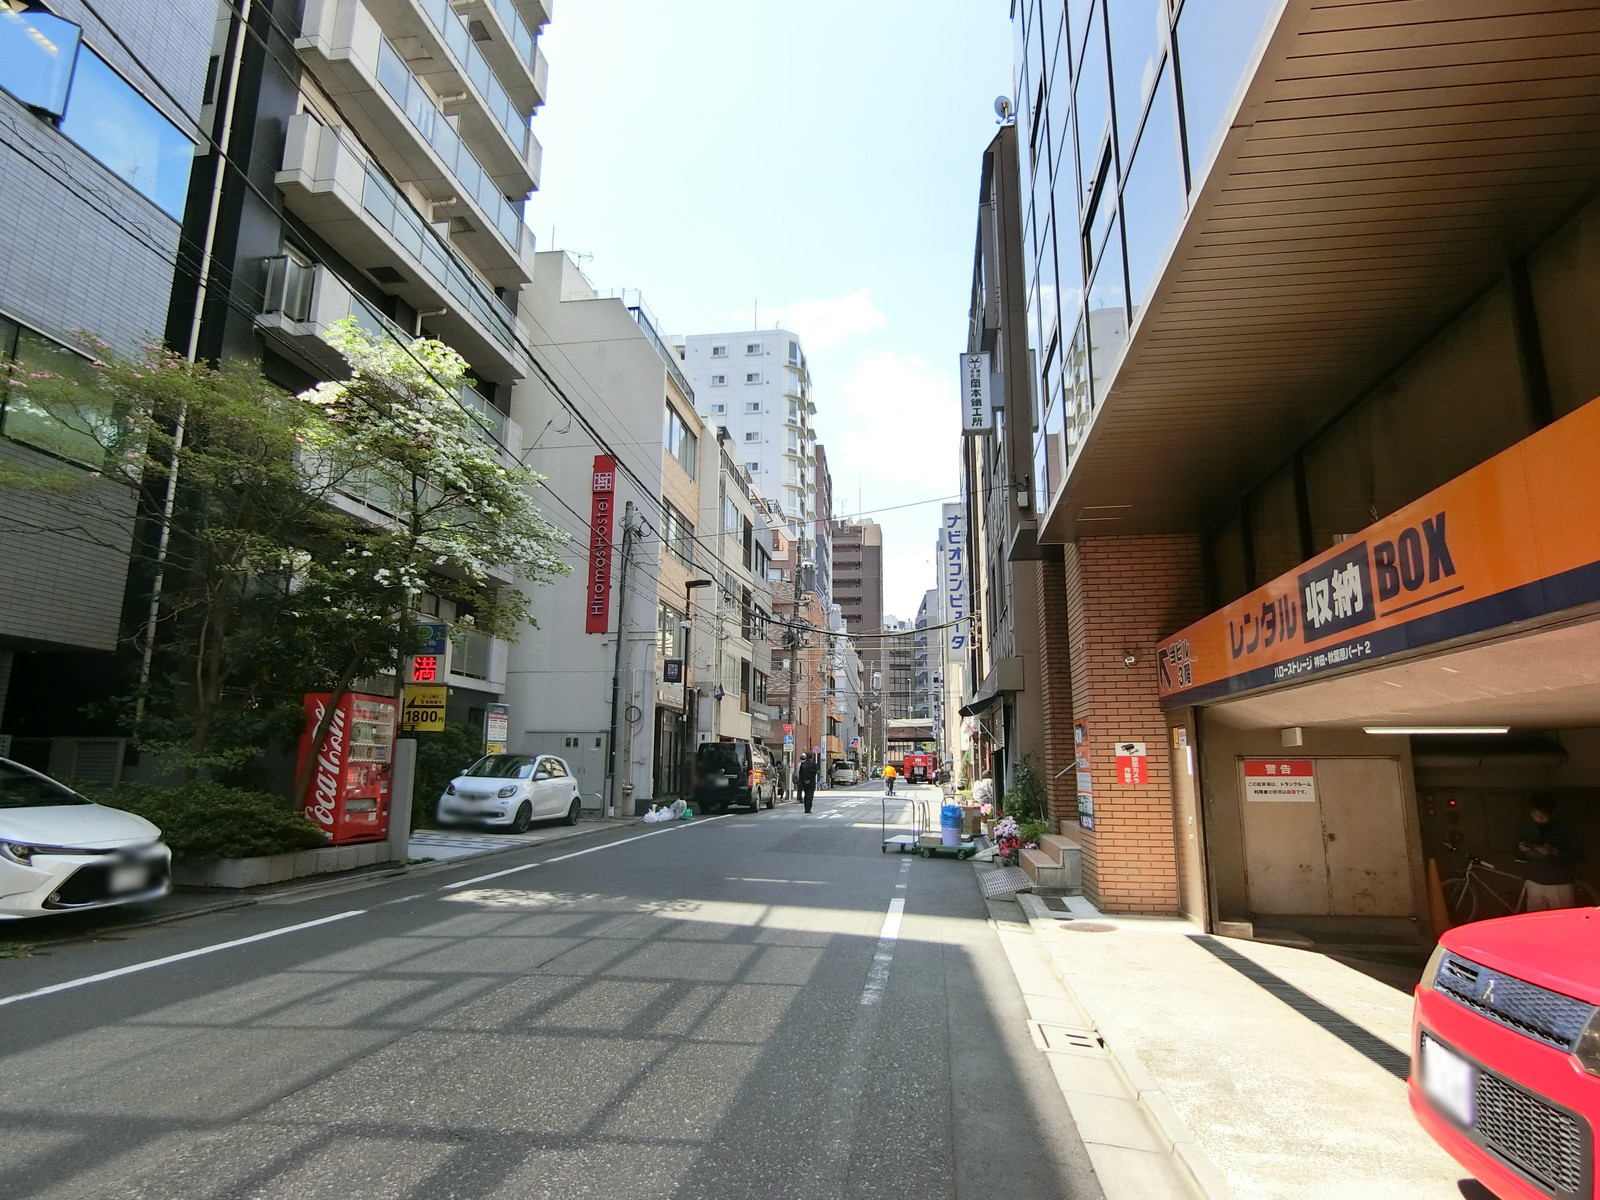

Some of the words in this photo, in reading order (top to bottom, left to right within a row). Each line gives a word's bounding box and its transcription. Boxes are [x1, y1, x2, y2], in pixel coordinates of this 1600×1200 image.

[1305, 562, 1363, 629] 収納
[1373, 511, 1457, 602] BOX
[947, 515, 965, 650] ナビオコンピュータ
[413, 656, 437, 681] 満
[1274, 656, 1313, 679] ハローストレージ
[405, 710, 444, 723] 1800円
[1264, 764, 1292, 775] 警告
